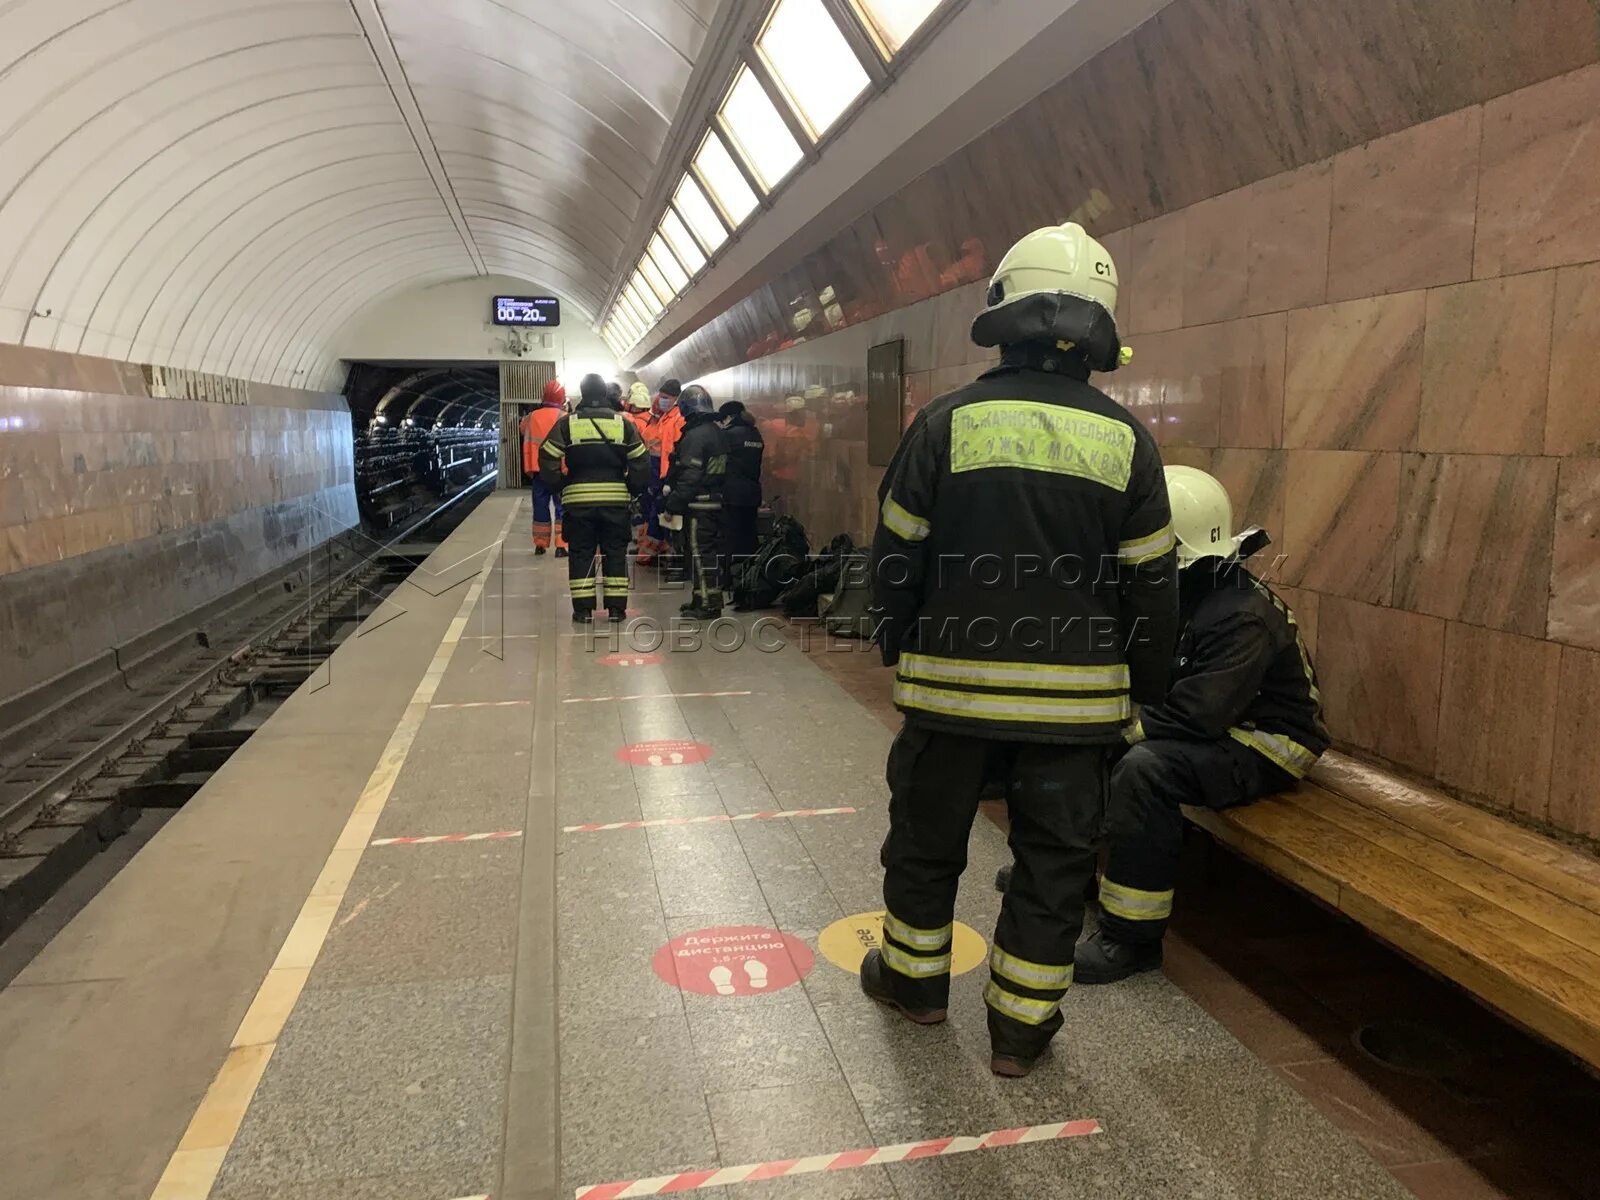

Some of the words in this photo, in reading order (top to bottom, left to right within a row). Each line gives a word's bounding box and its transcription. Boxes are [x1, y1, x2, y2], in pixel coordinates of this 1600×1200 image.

[497, 308, 515, 321] 00
[522, 309, 540, 322] 20
[961, 436, 1035, 457] СУЖБА
[684, 932, 771, 946] Держите
[677, 942, 785, 957] дистанцию
